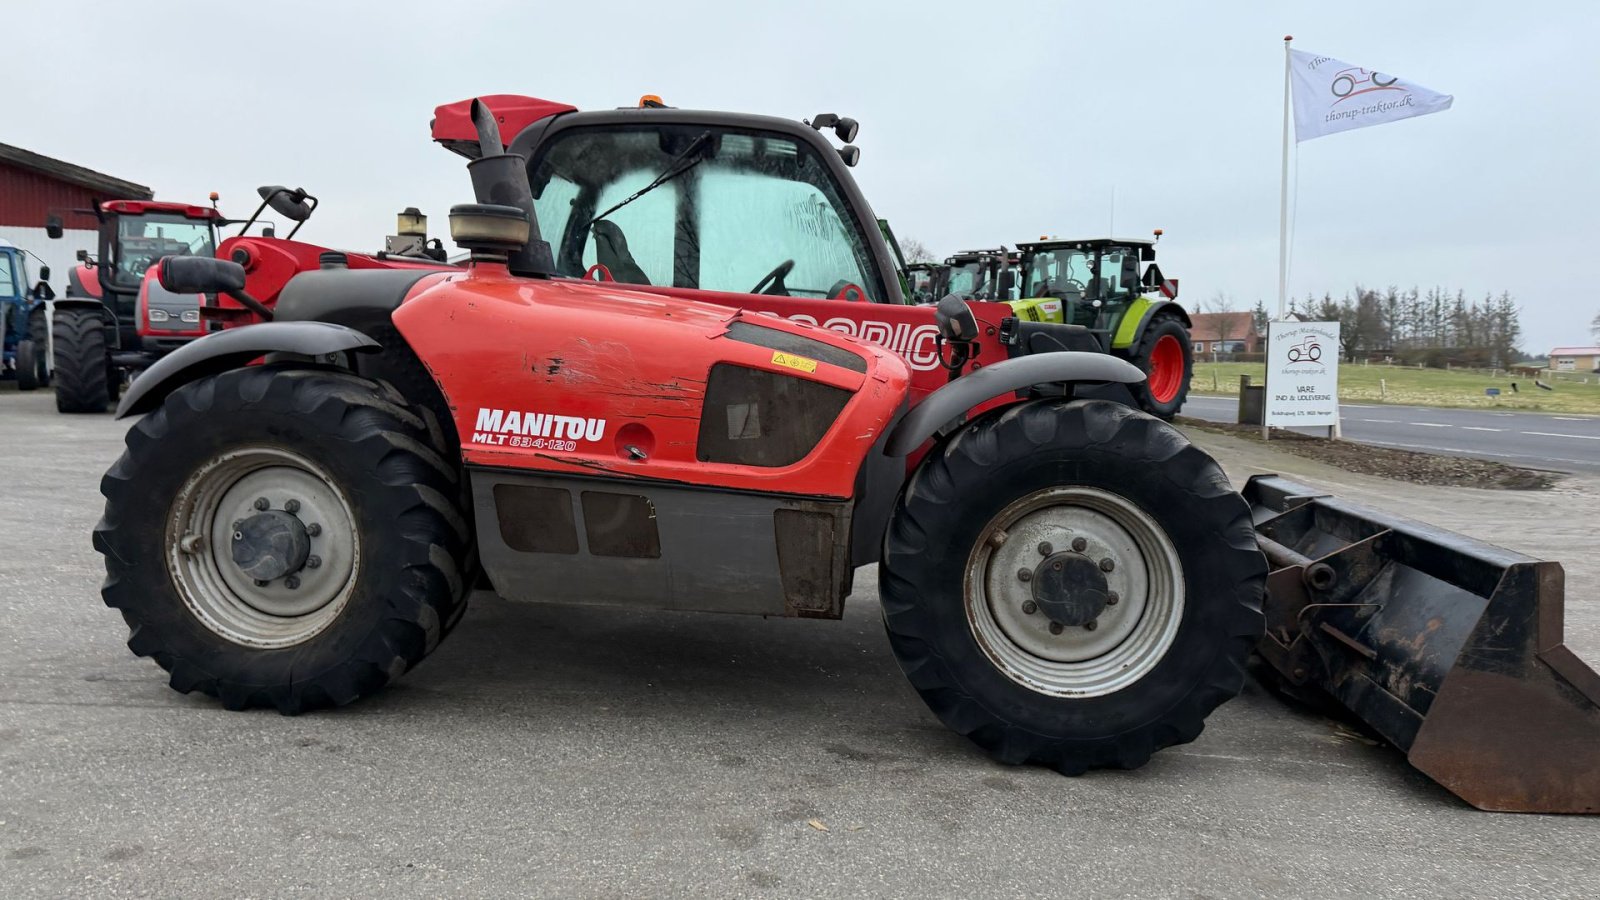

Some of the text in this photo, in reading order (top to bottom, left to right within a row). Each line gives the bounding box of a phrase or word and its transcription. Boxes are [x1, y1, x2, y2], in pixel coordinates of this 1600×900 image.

[1325, 94, 1415, 122] thorup-traktor.dk
[475, 407, 607, 442] MANITOU
[472, 432, 577, 452] MLT 634-120
